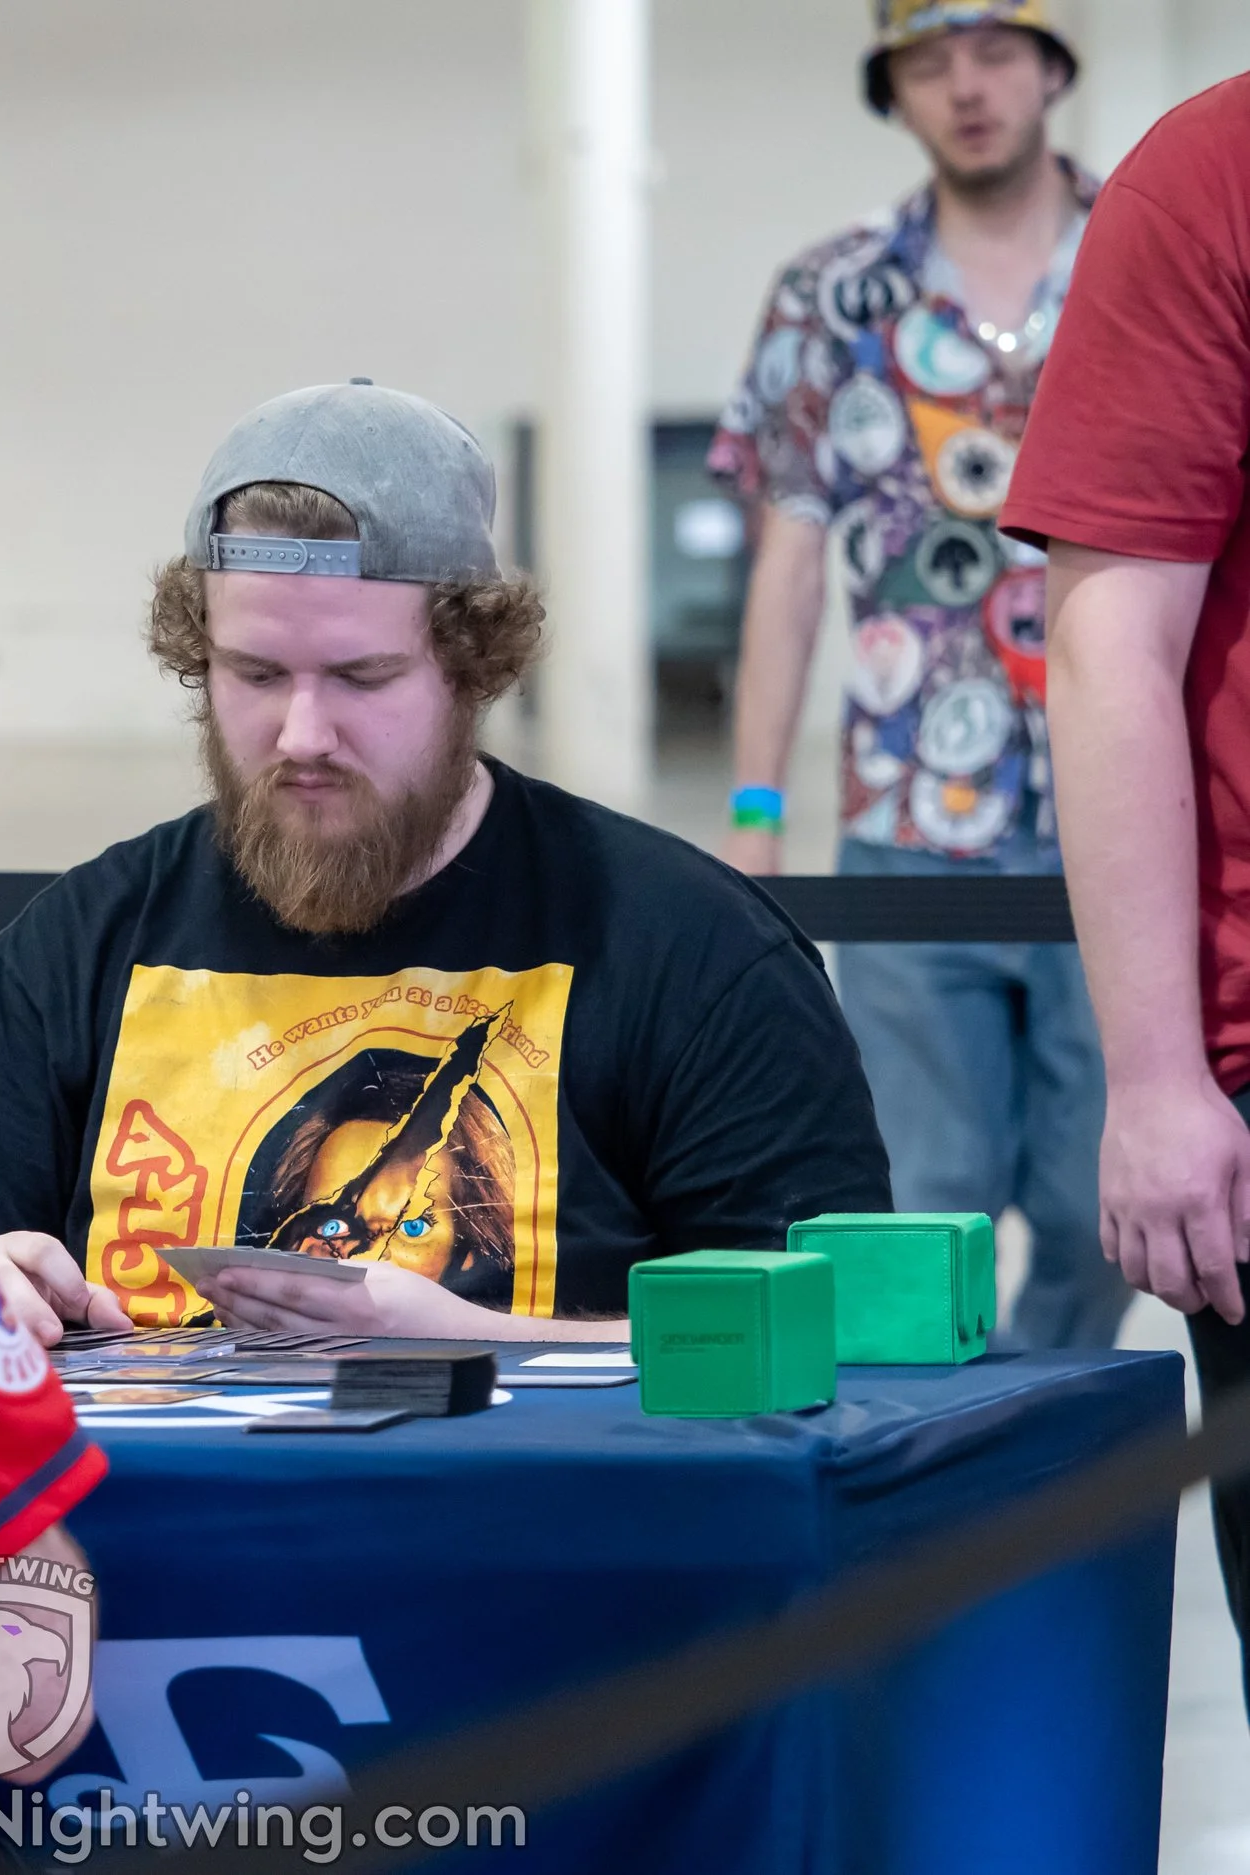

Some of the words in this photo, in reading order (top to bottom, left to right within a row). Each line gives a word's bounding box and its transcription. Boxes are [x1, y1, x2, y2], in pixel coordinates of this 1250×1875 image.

[246, 1040, 285, 1070] He
[283, 1005, 359, 1043] wants
[361, 986, 401, 1018] you
[406, 986, 432, 1007] as
[434, 996, 452, 1011] a
[453, 994, 495, 1017] bes
[497, 1018, 550, 1069] riend
